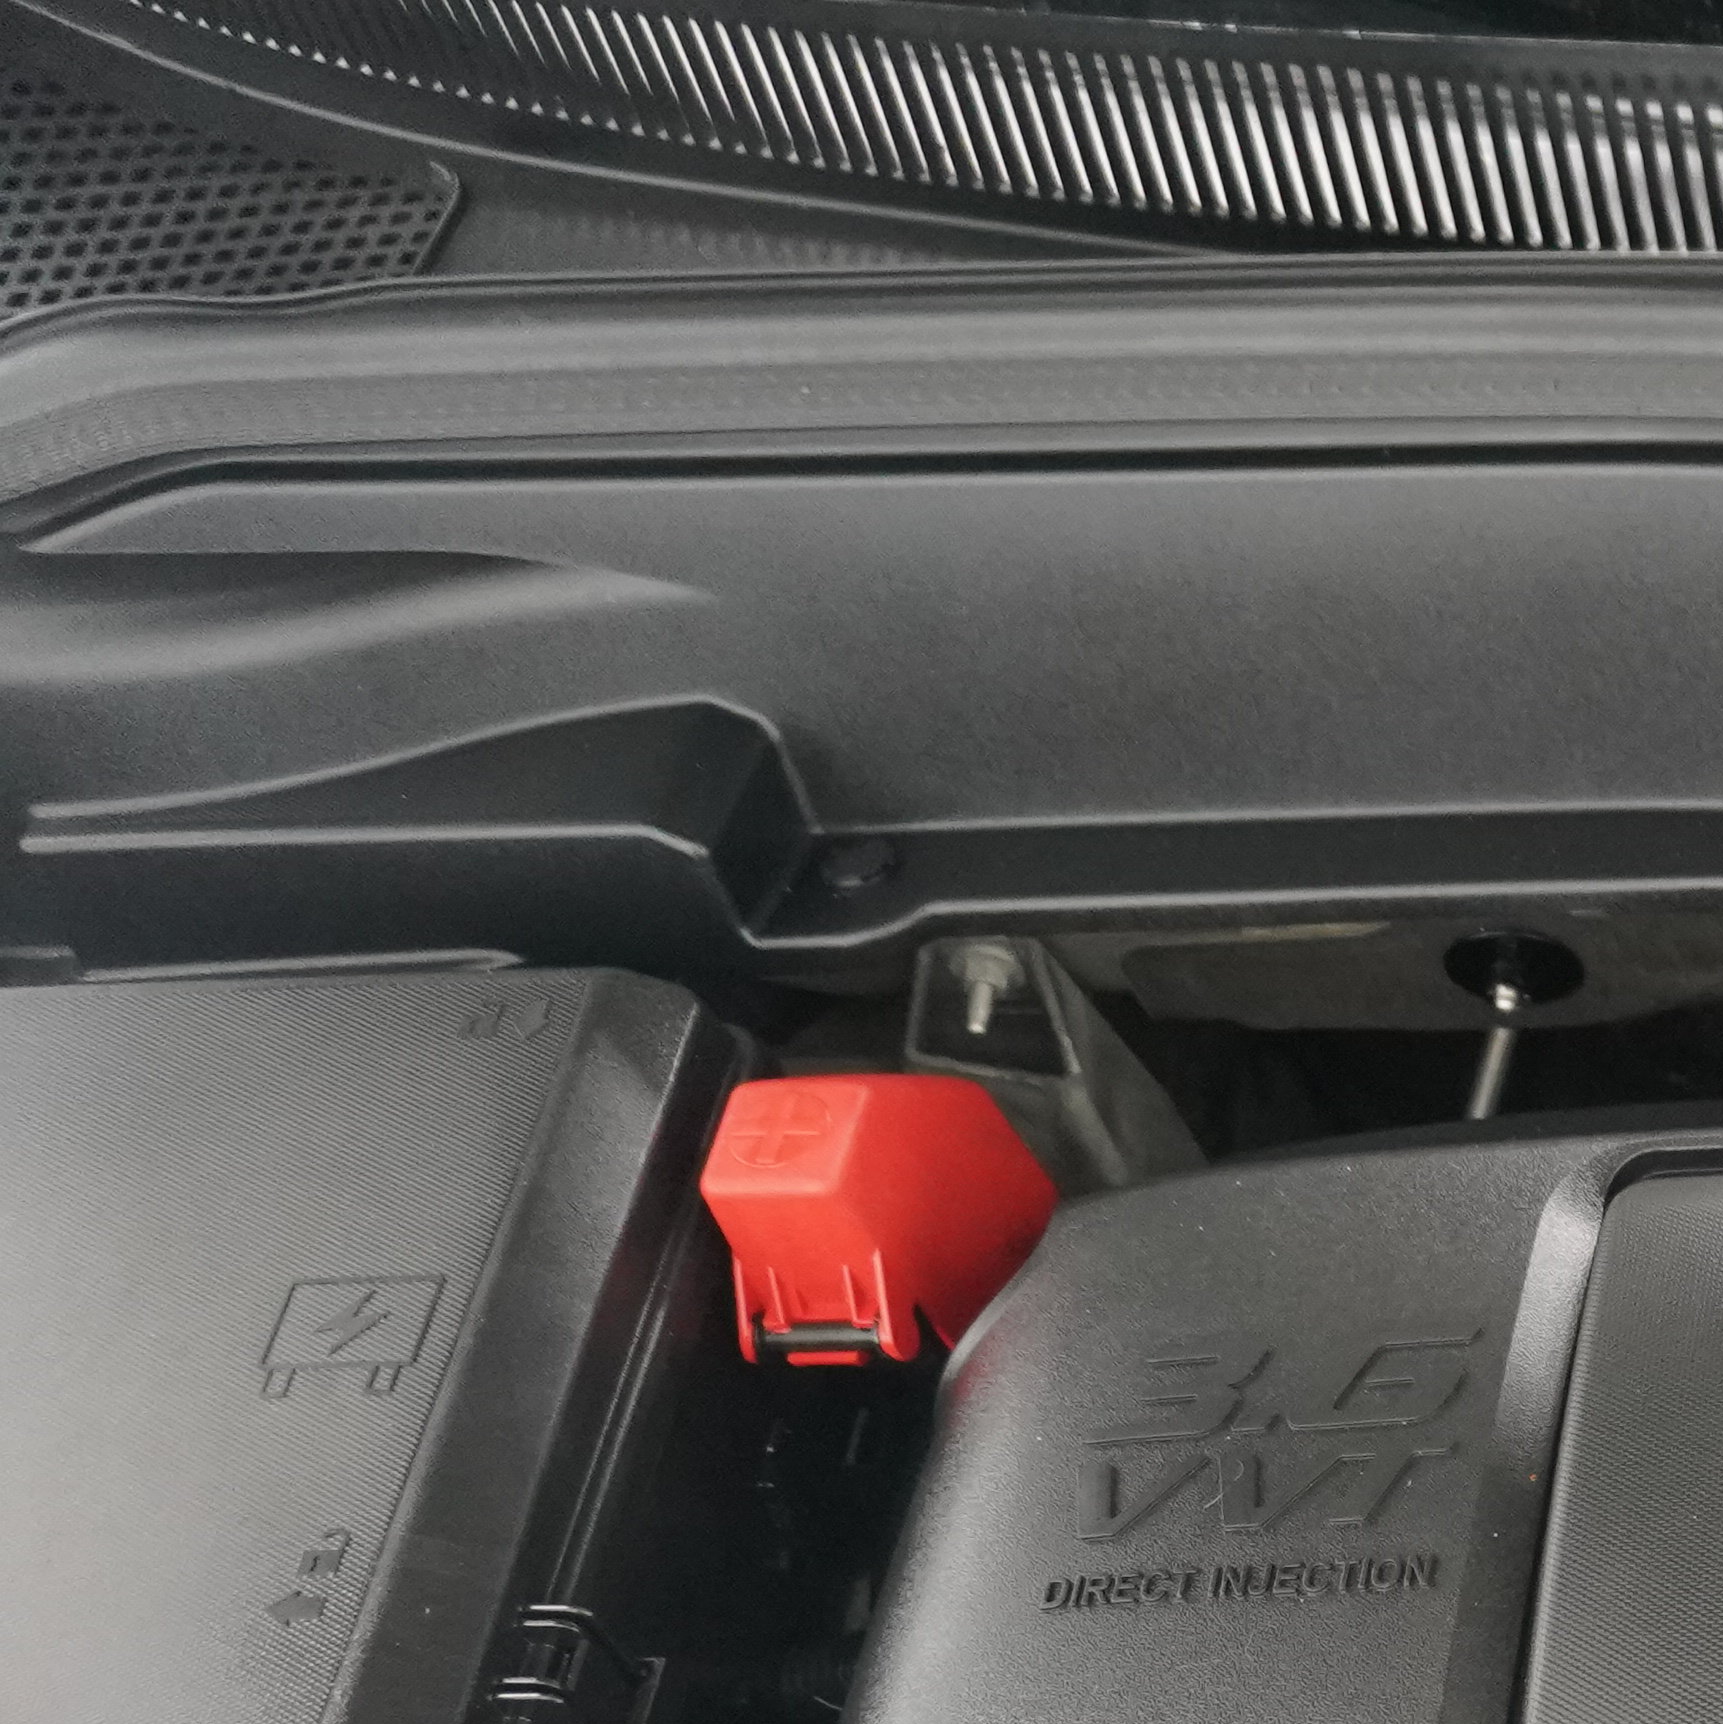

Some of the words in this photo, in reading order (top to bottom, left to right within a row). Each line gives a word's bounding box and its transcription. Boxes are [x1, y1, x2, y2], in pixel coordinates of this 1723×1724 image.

[1082, 1326, 1485, 1446] 3.6
[1076, 1441, 1459, 1540] VVT
[1038, 1568, 1198, 1612] DIRECT
[1207, 1554, 1440, 1603] INJECTION
